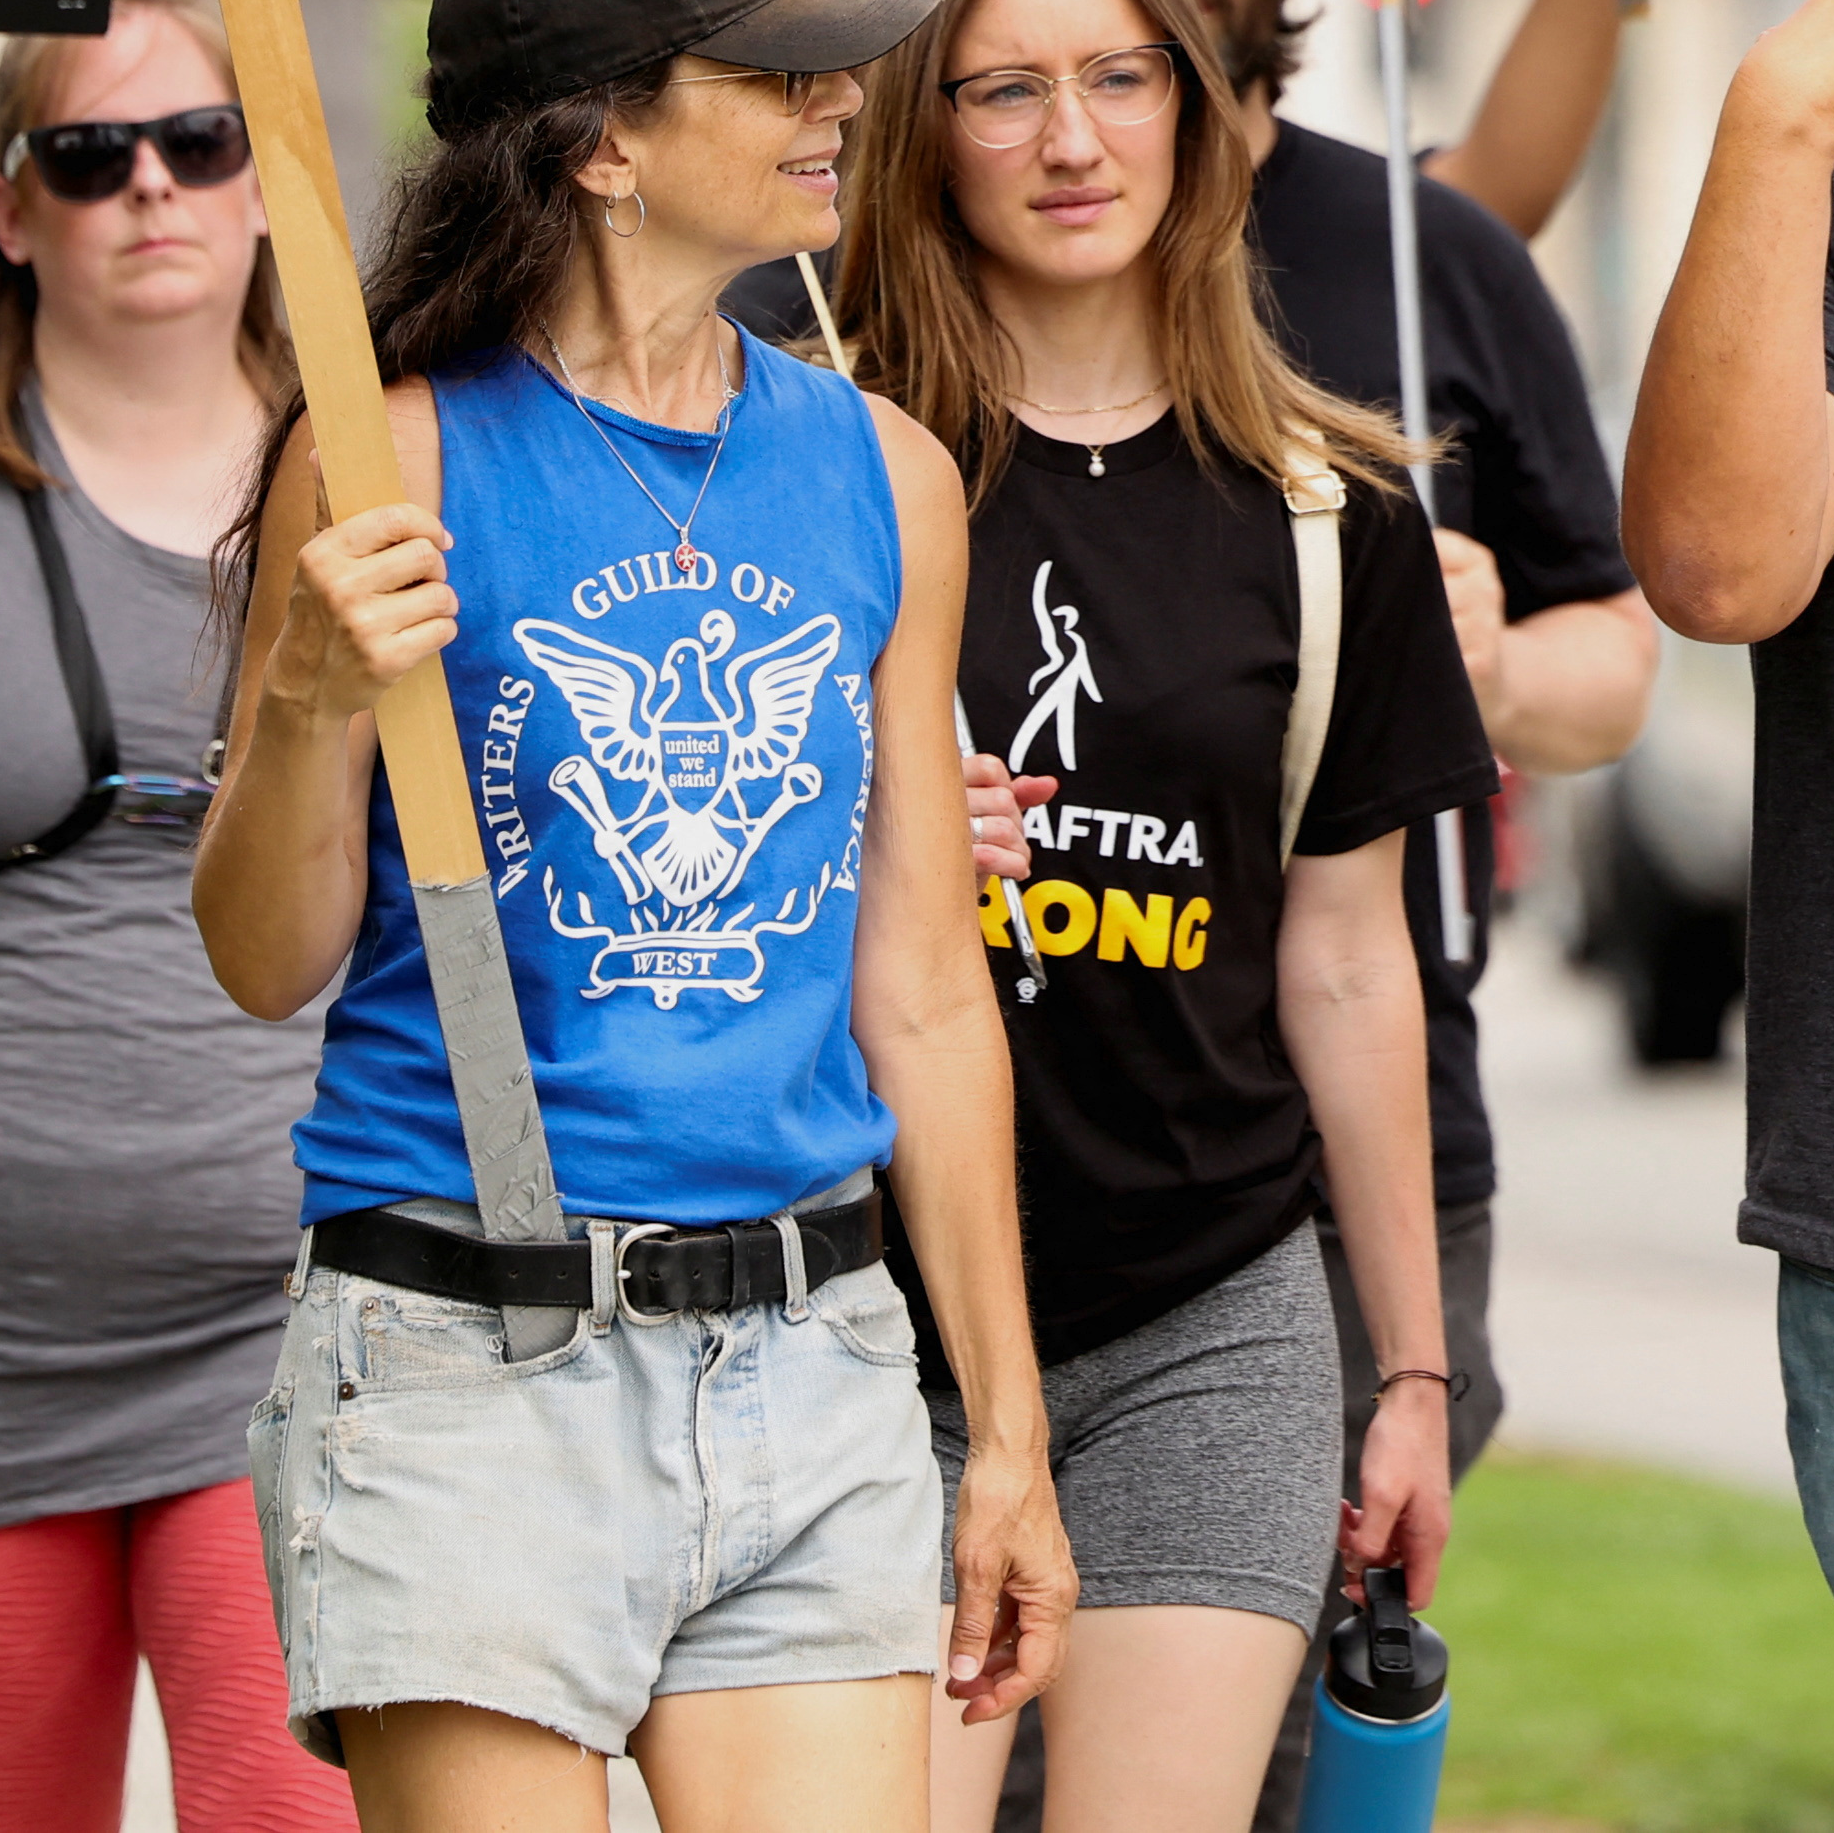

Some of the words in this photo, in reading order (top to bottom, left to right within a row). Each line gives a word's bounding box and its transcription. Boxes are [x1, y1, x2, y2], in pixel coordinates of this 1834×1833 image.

[481, 675, 535, 899] WRITERS
[572, 551, 718, 620] GUILD
[731, 562, 796, 617] OF
[831, 674, 874, 892] AMERICA
[664, 734, 720, 754] united
[679, 756, 705, 771] we
[668, 766, 717, 788] stand
[632, 952, 718, 977] WEST
